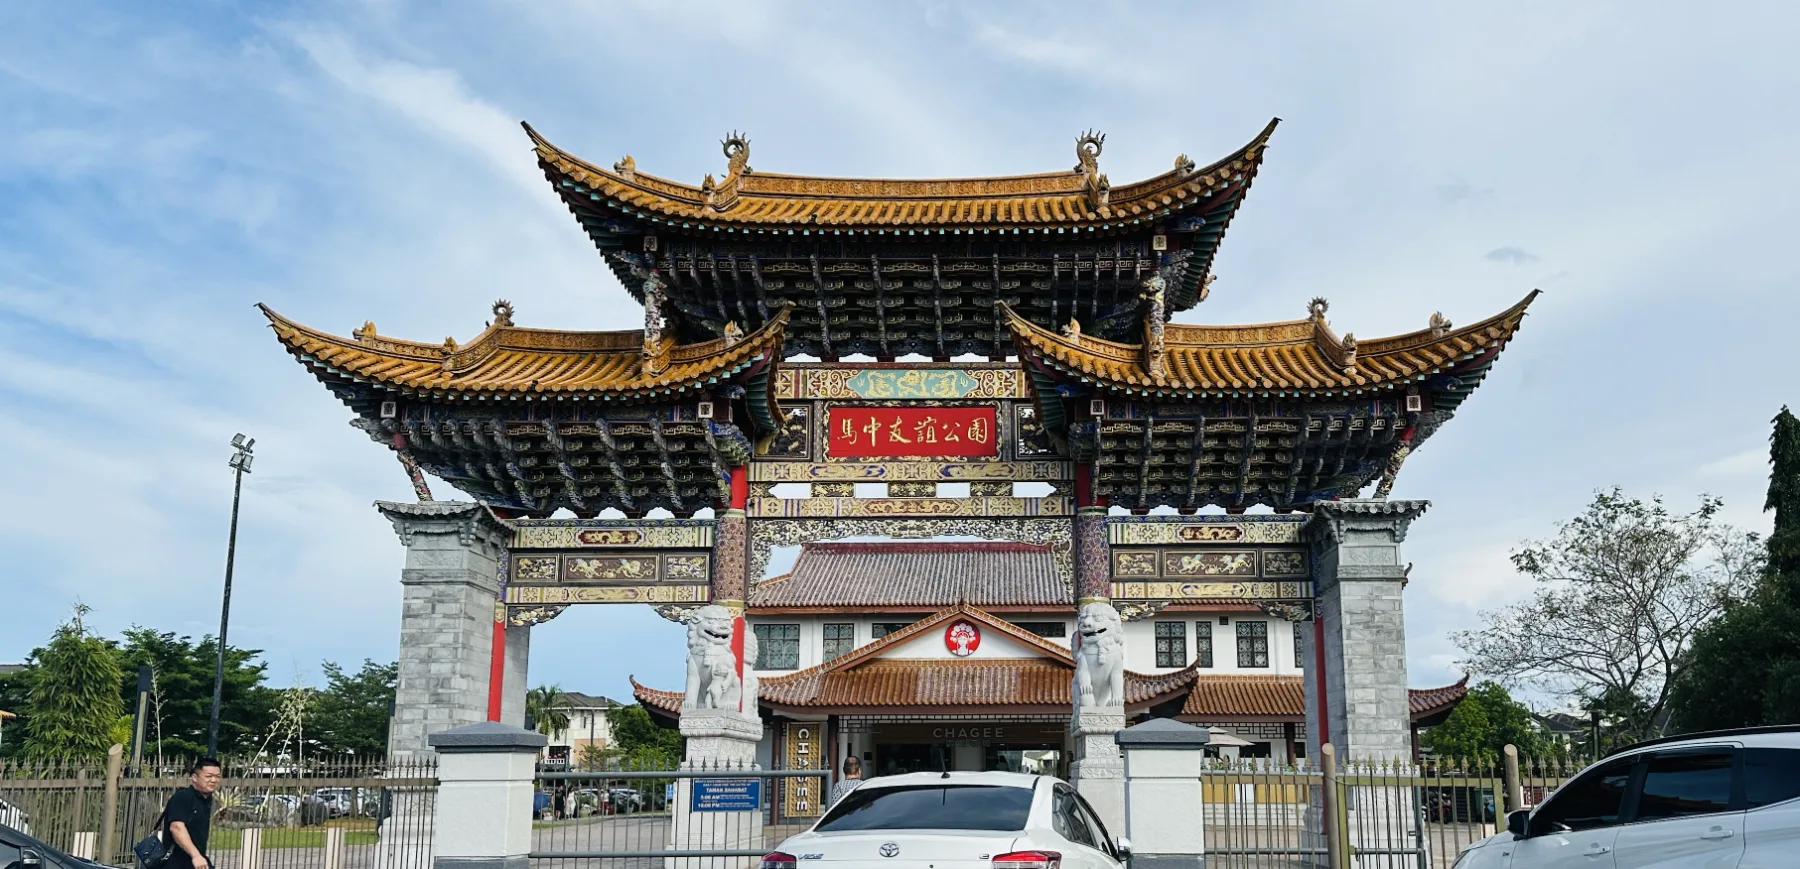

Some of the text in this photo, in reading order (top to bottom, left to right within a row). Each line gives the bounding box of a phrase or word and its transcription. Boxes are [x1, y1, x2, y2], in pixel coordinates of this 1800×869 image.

[836, 415, 988, 447] 馬中友誼公園
[933, 728, 1004, 738] CHAGEE
